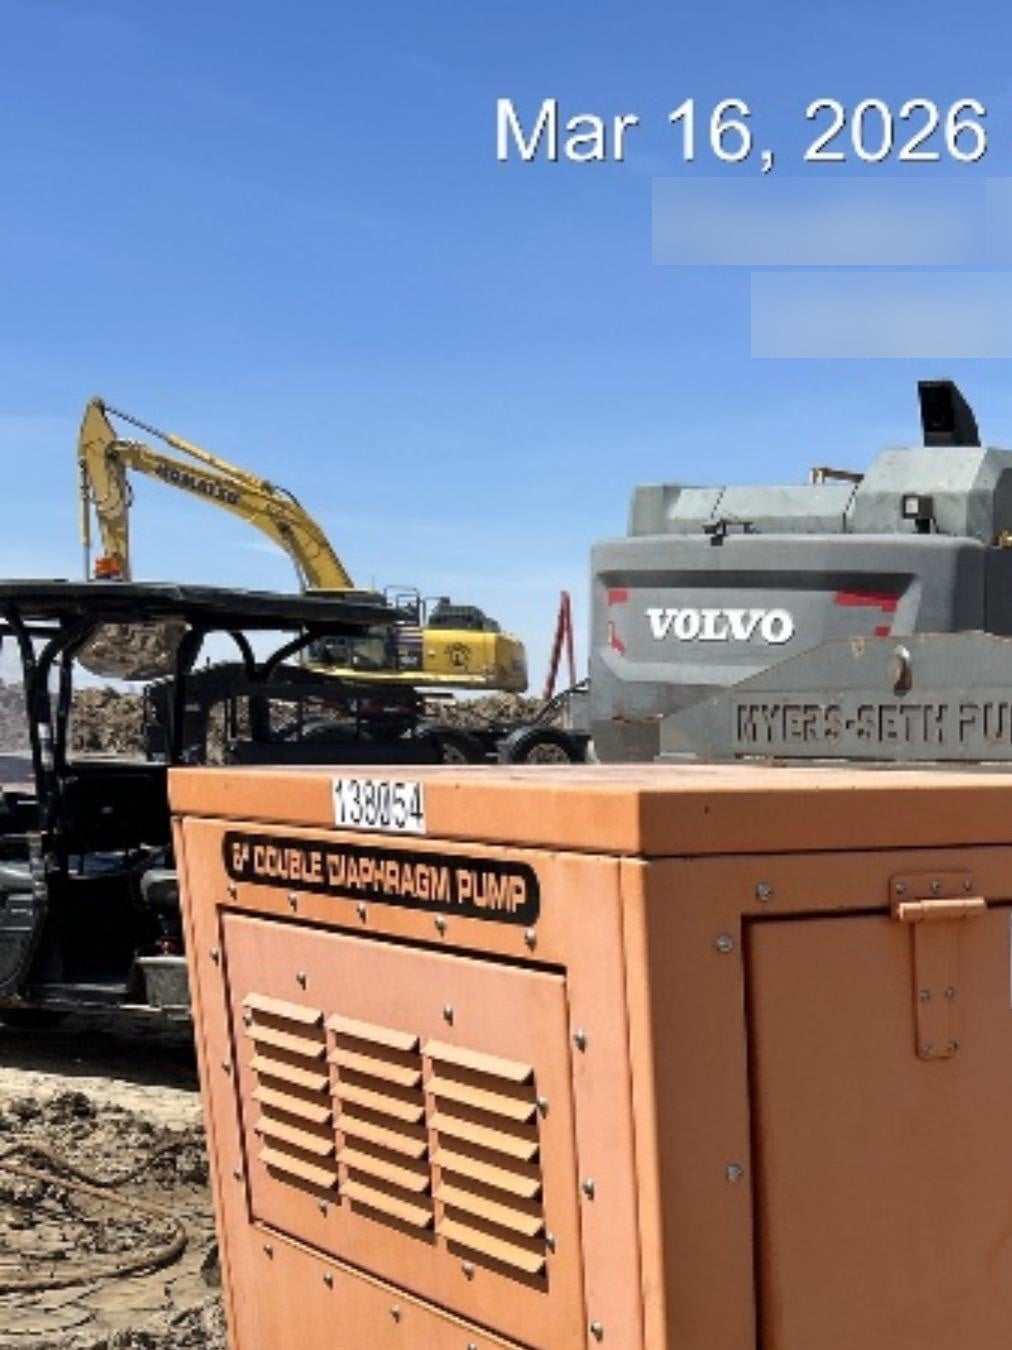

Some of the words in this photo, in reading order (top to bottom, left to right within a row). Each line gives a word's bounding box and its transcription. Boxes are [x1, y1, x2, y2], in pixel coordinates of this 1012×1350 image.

[645, 607, 795, 646] VOLVO
[736, 702, 949, 744] MYERS-SETH
[335, 778, 424, 828] 138054
[253, 845, 324, 884] DOUBLE
[326, 853, 451, 904] DIAPHRAGM
[455, 868, 527, 913] PUMP
